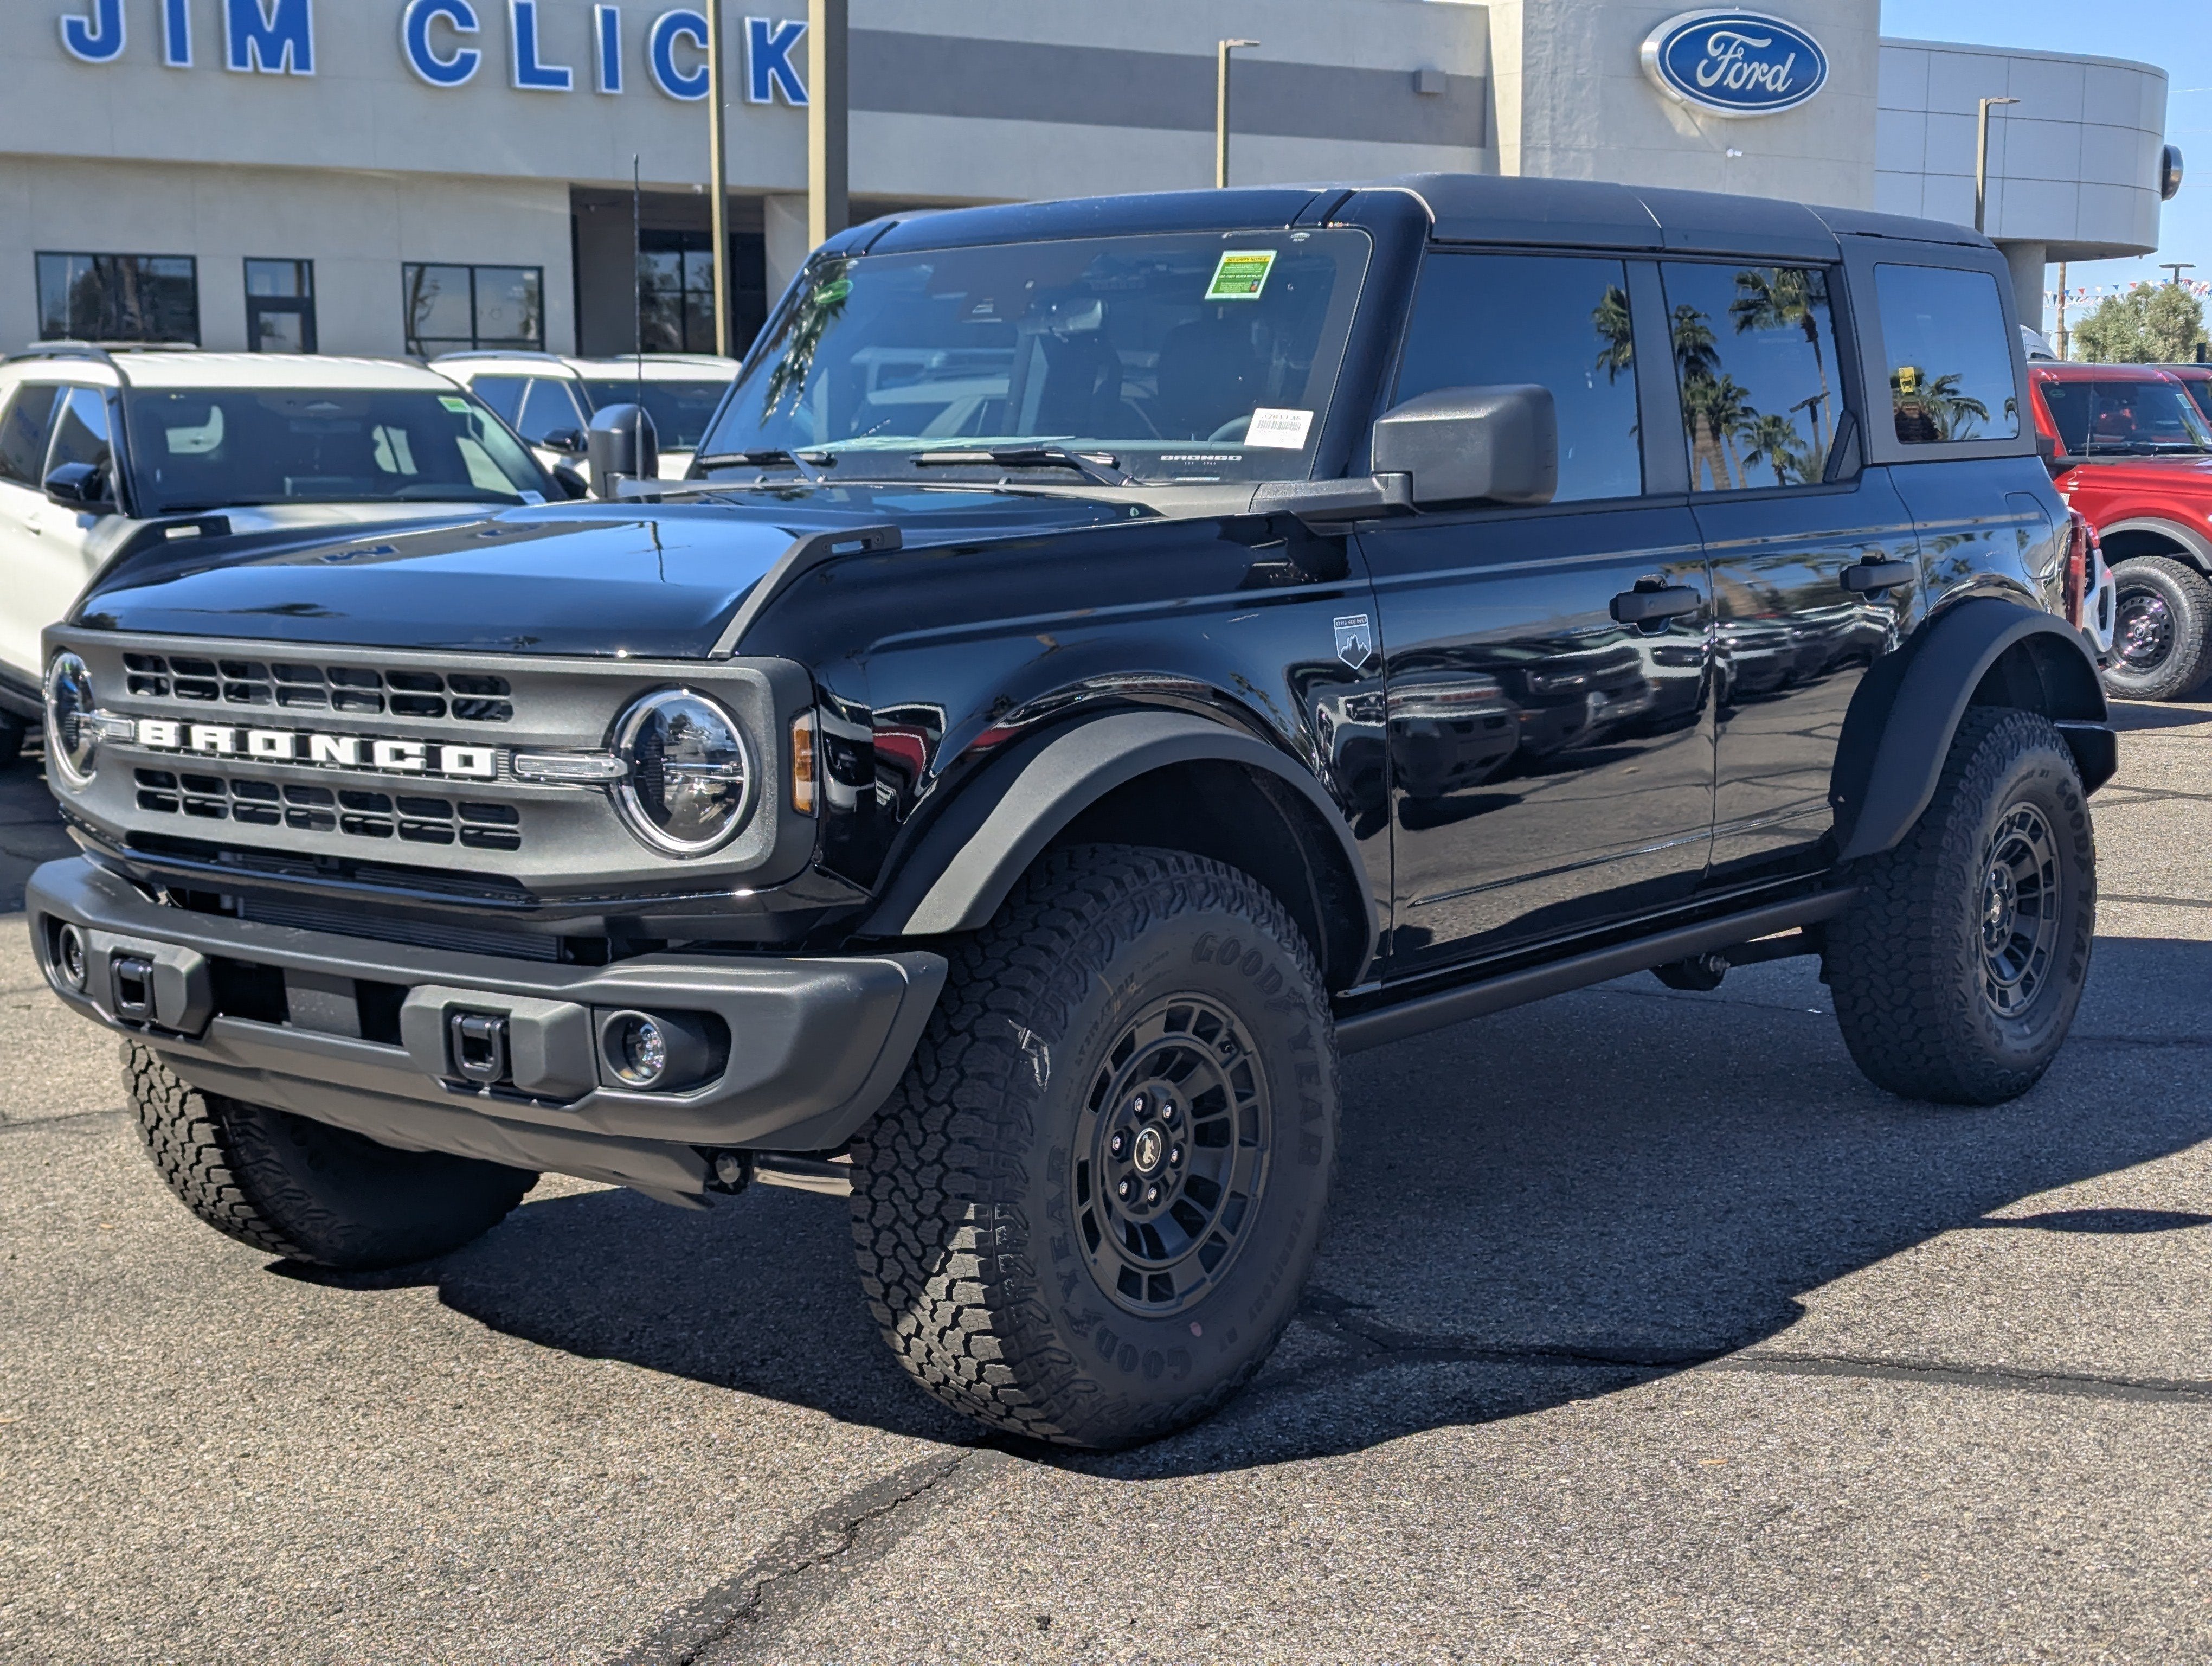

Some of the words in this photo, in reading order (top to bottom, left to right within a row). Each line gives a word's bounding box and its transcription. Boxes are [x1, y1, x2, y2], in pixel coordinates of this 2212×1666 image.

[61, 0, 316, 75] JIM
[401, 0, 809, 106] CLICK
[1696, 30, 1796, 92] Ford
[138, 719, 497, 779] BRONCO
